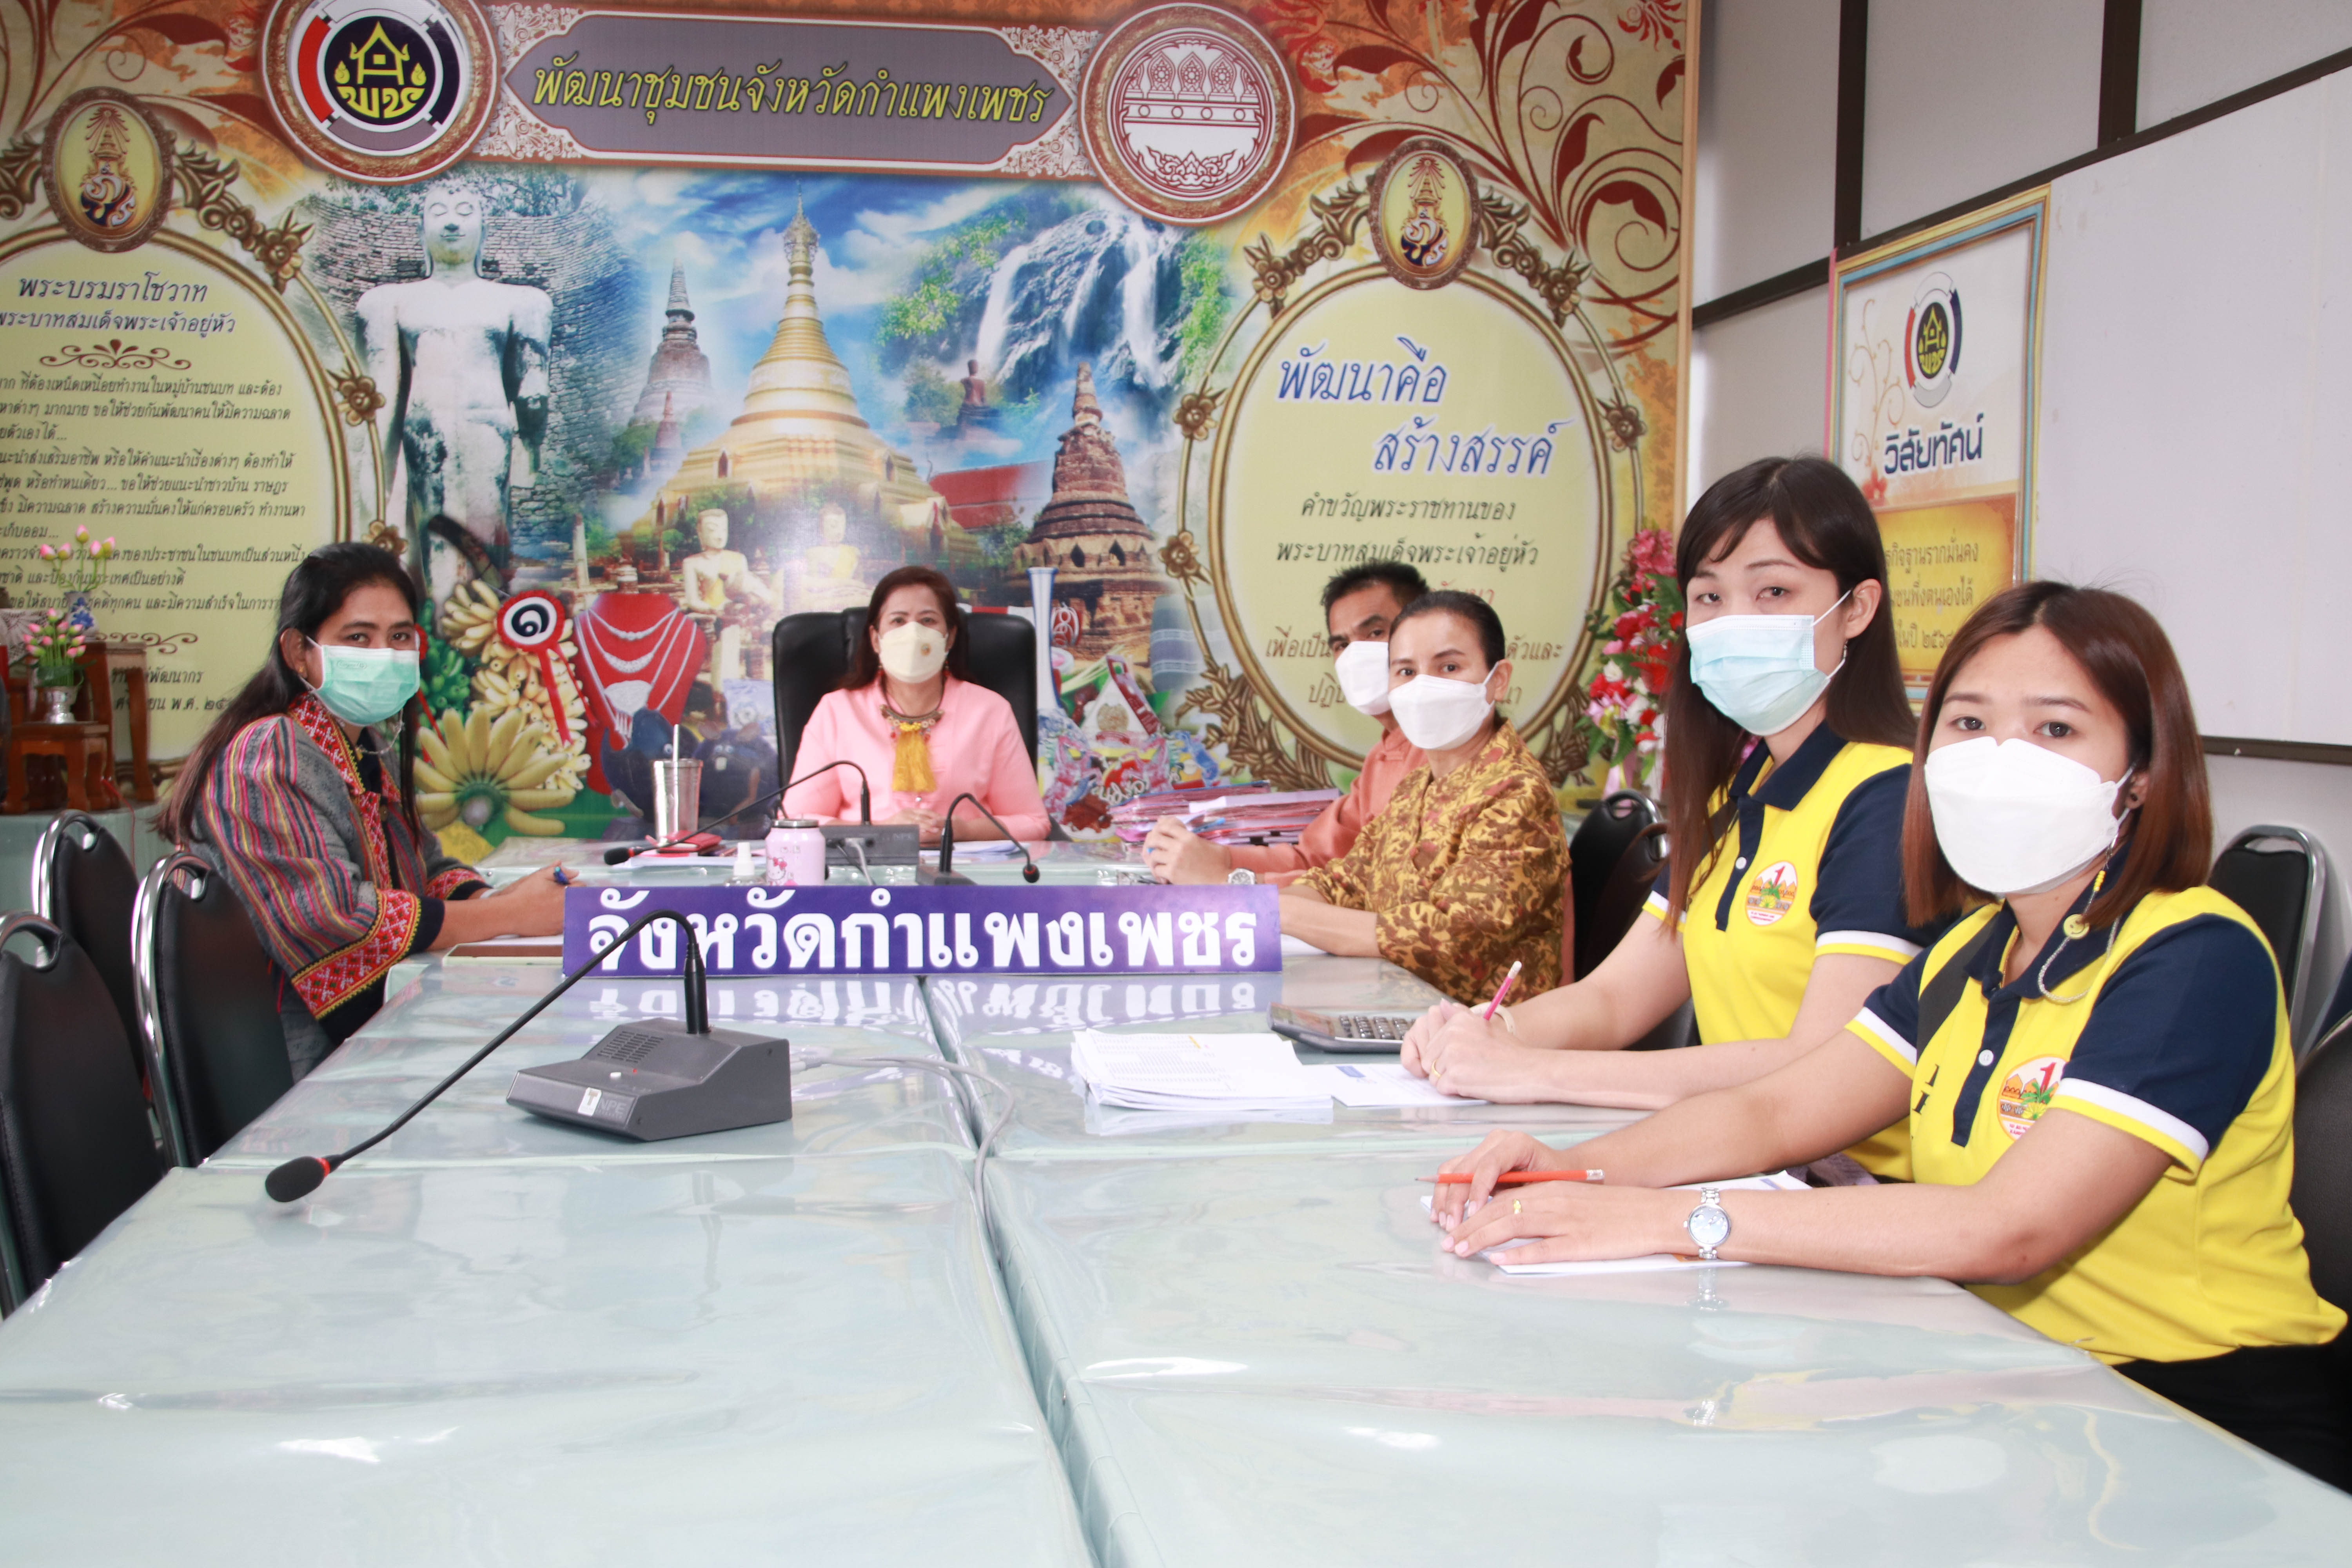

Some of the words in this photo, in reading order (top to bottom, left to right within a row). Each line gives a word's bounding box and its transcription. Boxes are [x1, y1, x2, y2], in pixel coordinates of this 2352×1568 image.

[532, 50, 1055, 125] พัฒนาชุมชนจังหวัดกำแพงเพชร
[19, 271, 207, 302] พระบรมราโชวาท
[1278, 336, 1448, 404] พัฒนาคือ
[44, 404, 89, 416] มากมาย
[1374, 416, 1574, 475] สร้างสรรค์
[1885, 411, 1985, 475] วิสัยทัศน์
[18, 494, 87, 514] มีความฉลาด
[1302, 490, 1515, 523] คำขวัญพระราชทานของ
[1276, 532, 1539, 573] พระบาทสมเด็จพระเจ้าอยู่หัว
[589, 887, 1257, 971] จังหวัดกำแพงเพชร
[2040, 1062, 2057, 1090] 1
